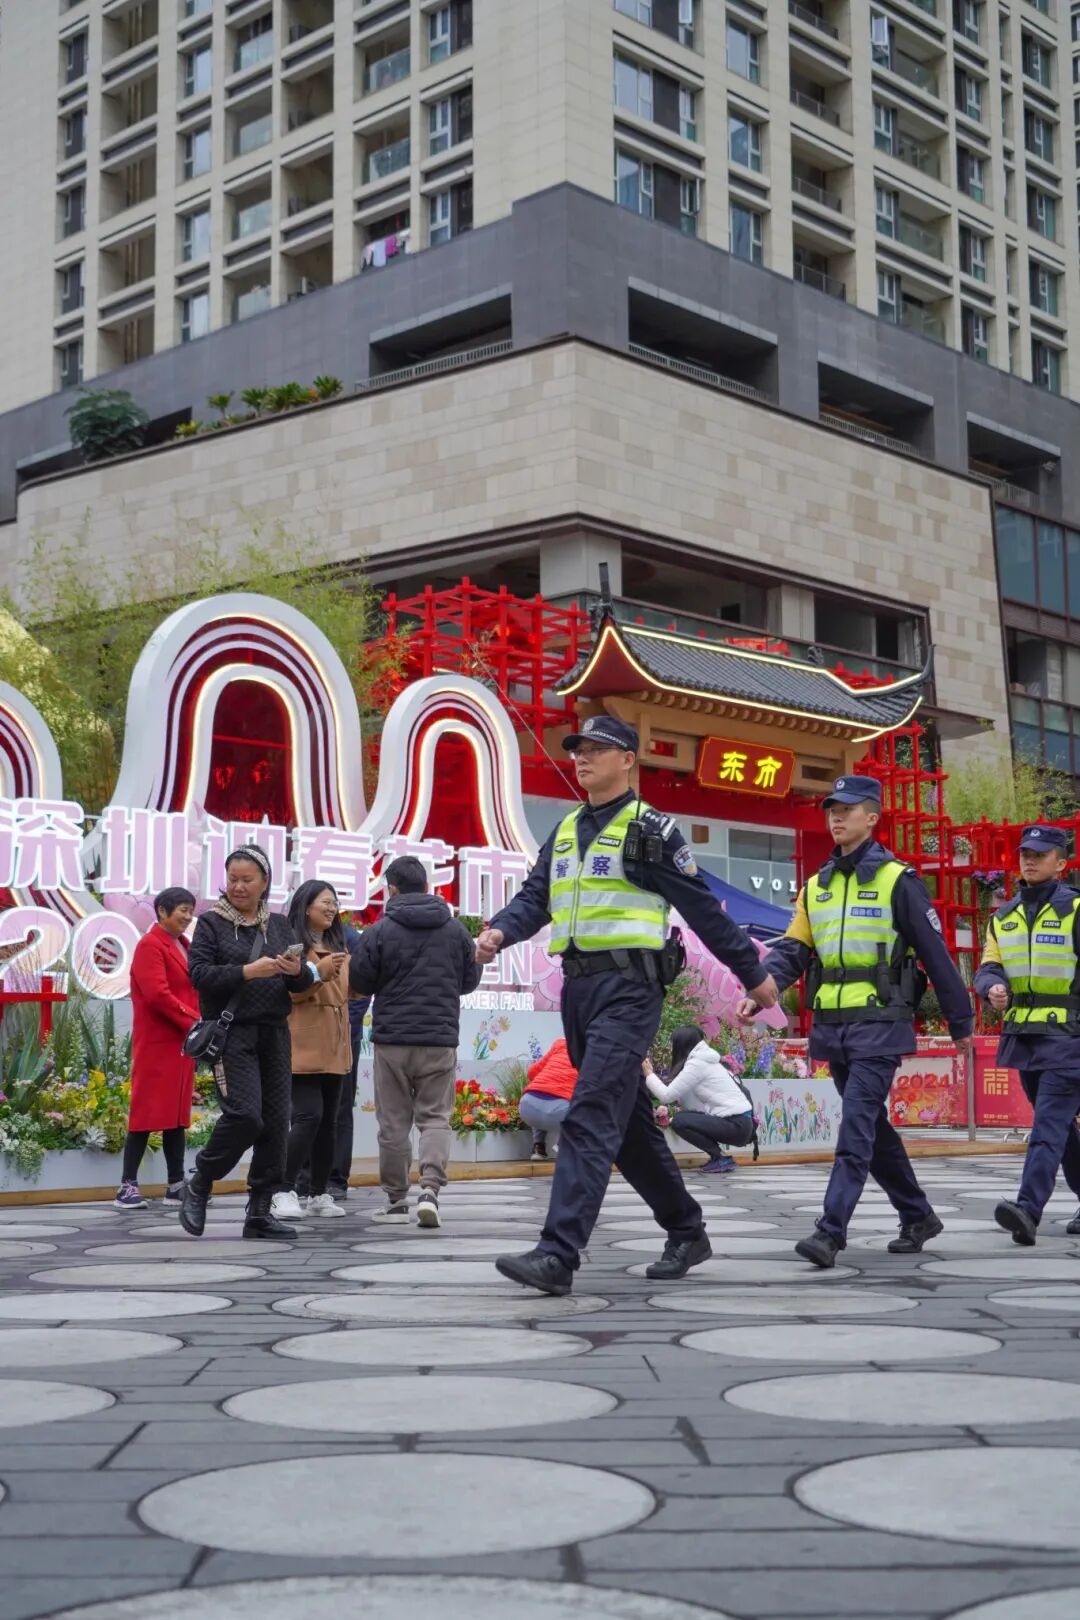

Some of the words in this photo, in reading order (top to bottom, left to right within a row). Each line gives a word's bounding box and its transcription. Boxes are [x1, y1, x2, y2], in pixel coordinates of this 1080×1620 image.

[719, 751, 783, 788] 东市
[500, 990, 534, 1011] FAIR
[897, 1073, 949, 1089] 2024
